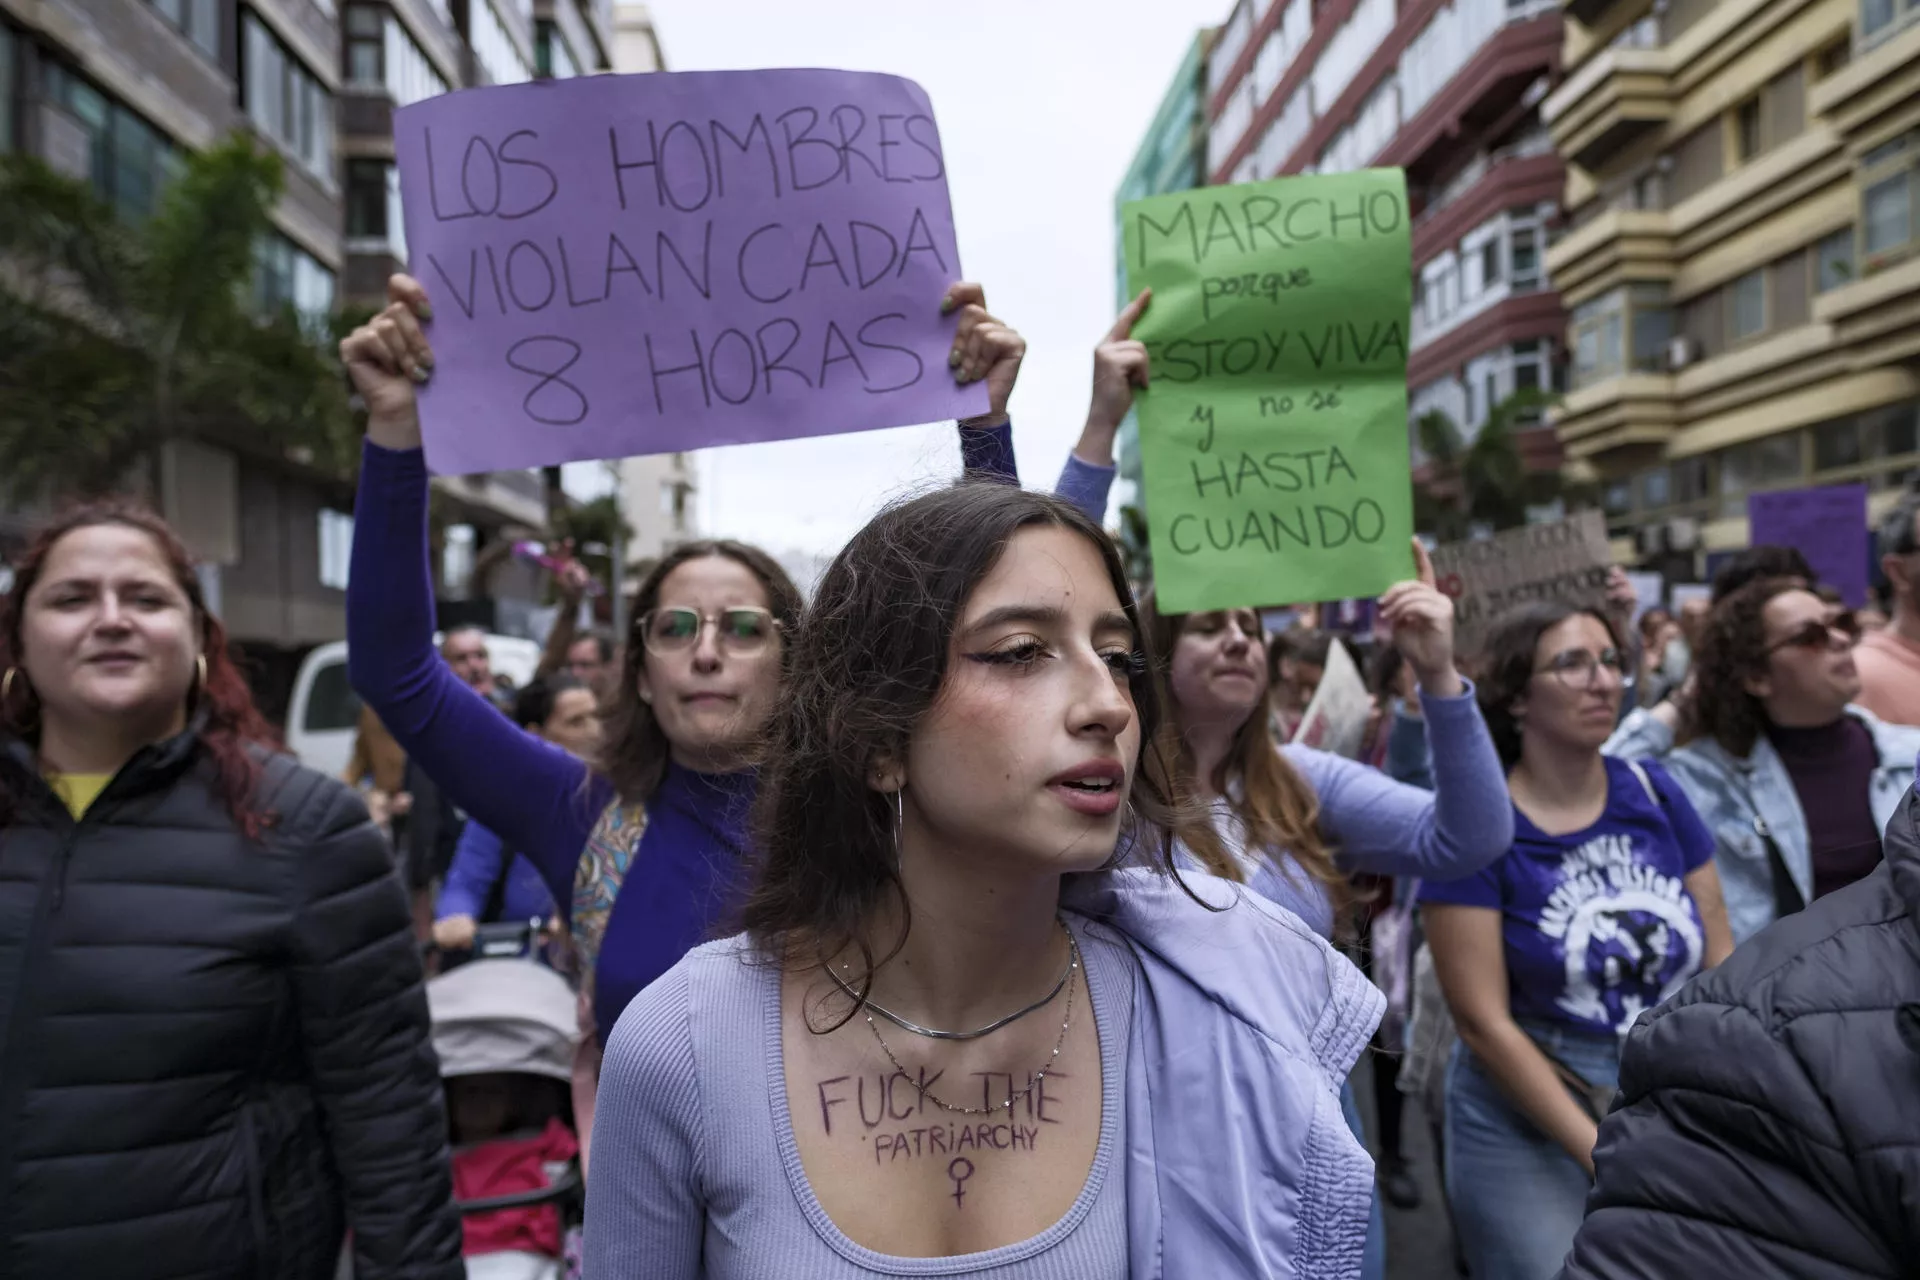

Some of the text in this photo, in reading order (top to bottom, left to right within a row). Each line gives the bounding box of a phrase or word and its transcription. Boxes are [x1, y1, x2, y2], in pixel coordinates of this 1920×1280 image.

[424, 104, 944, 221] LOS HOMBRES
[426, 207, 949, 319] VIOLAN CADA
[1137, 189, 1400, 268] MARCHO
[1202, 266, 1314, 321] porque
[505, 312, 924, 426] 8 HORAS
[1298, 319, 1407, 370] VIVA
[1189, 384, 1344, 454] y no sé
[1190, 445, 1357, 499] HASTA
[1169, 497, 1386, 556] CUANDO
[817, 1065, 1073, 1136] FUCK THE
